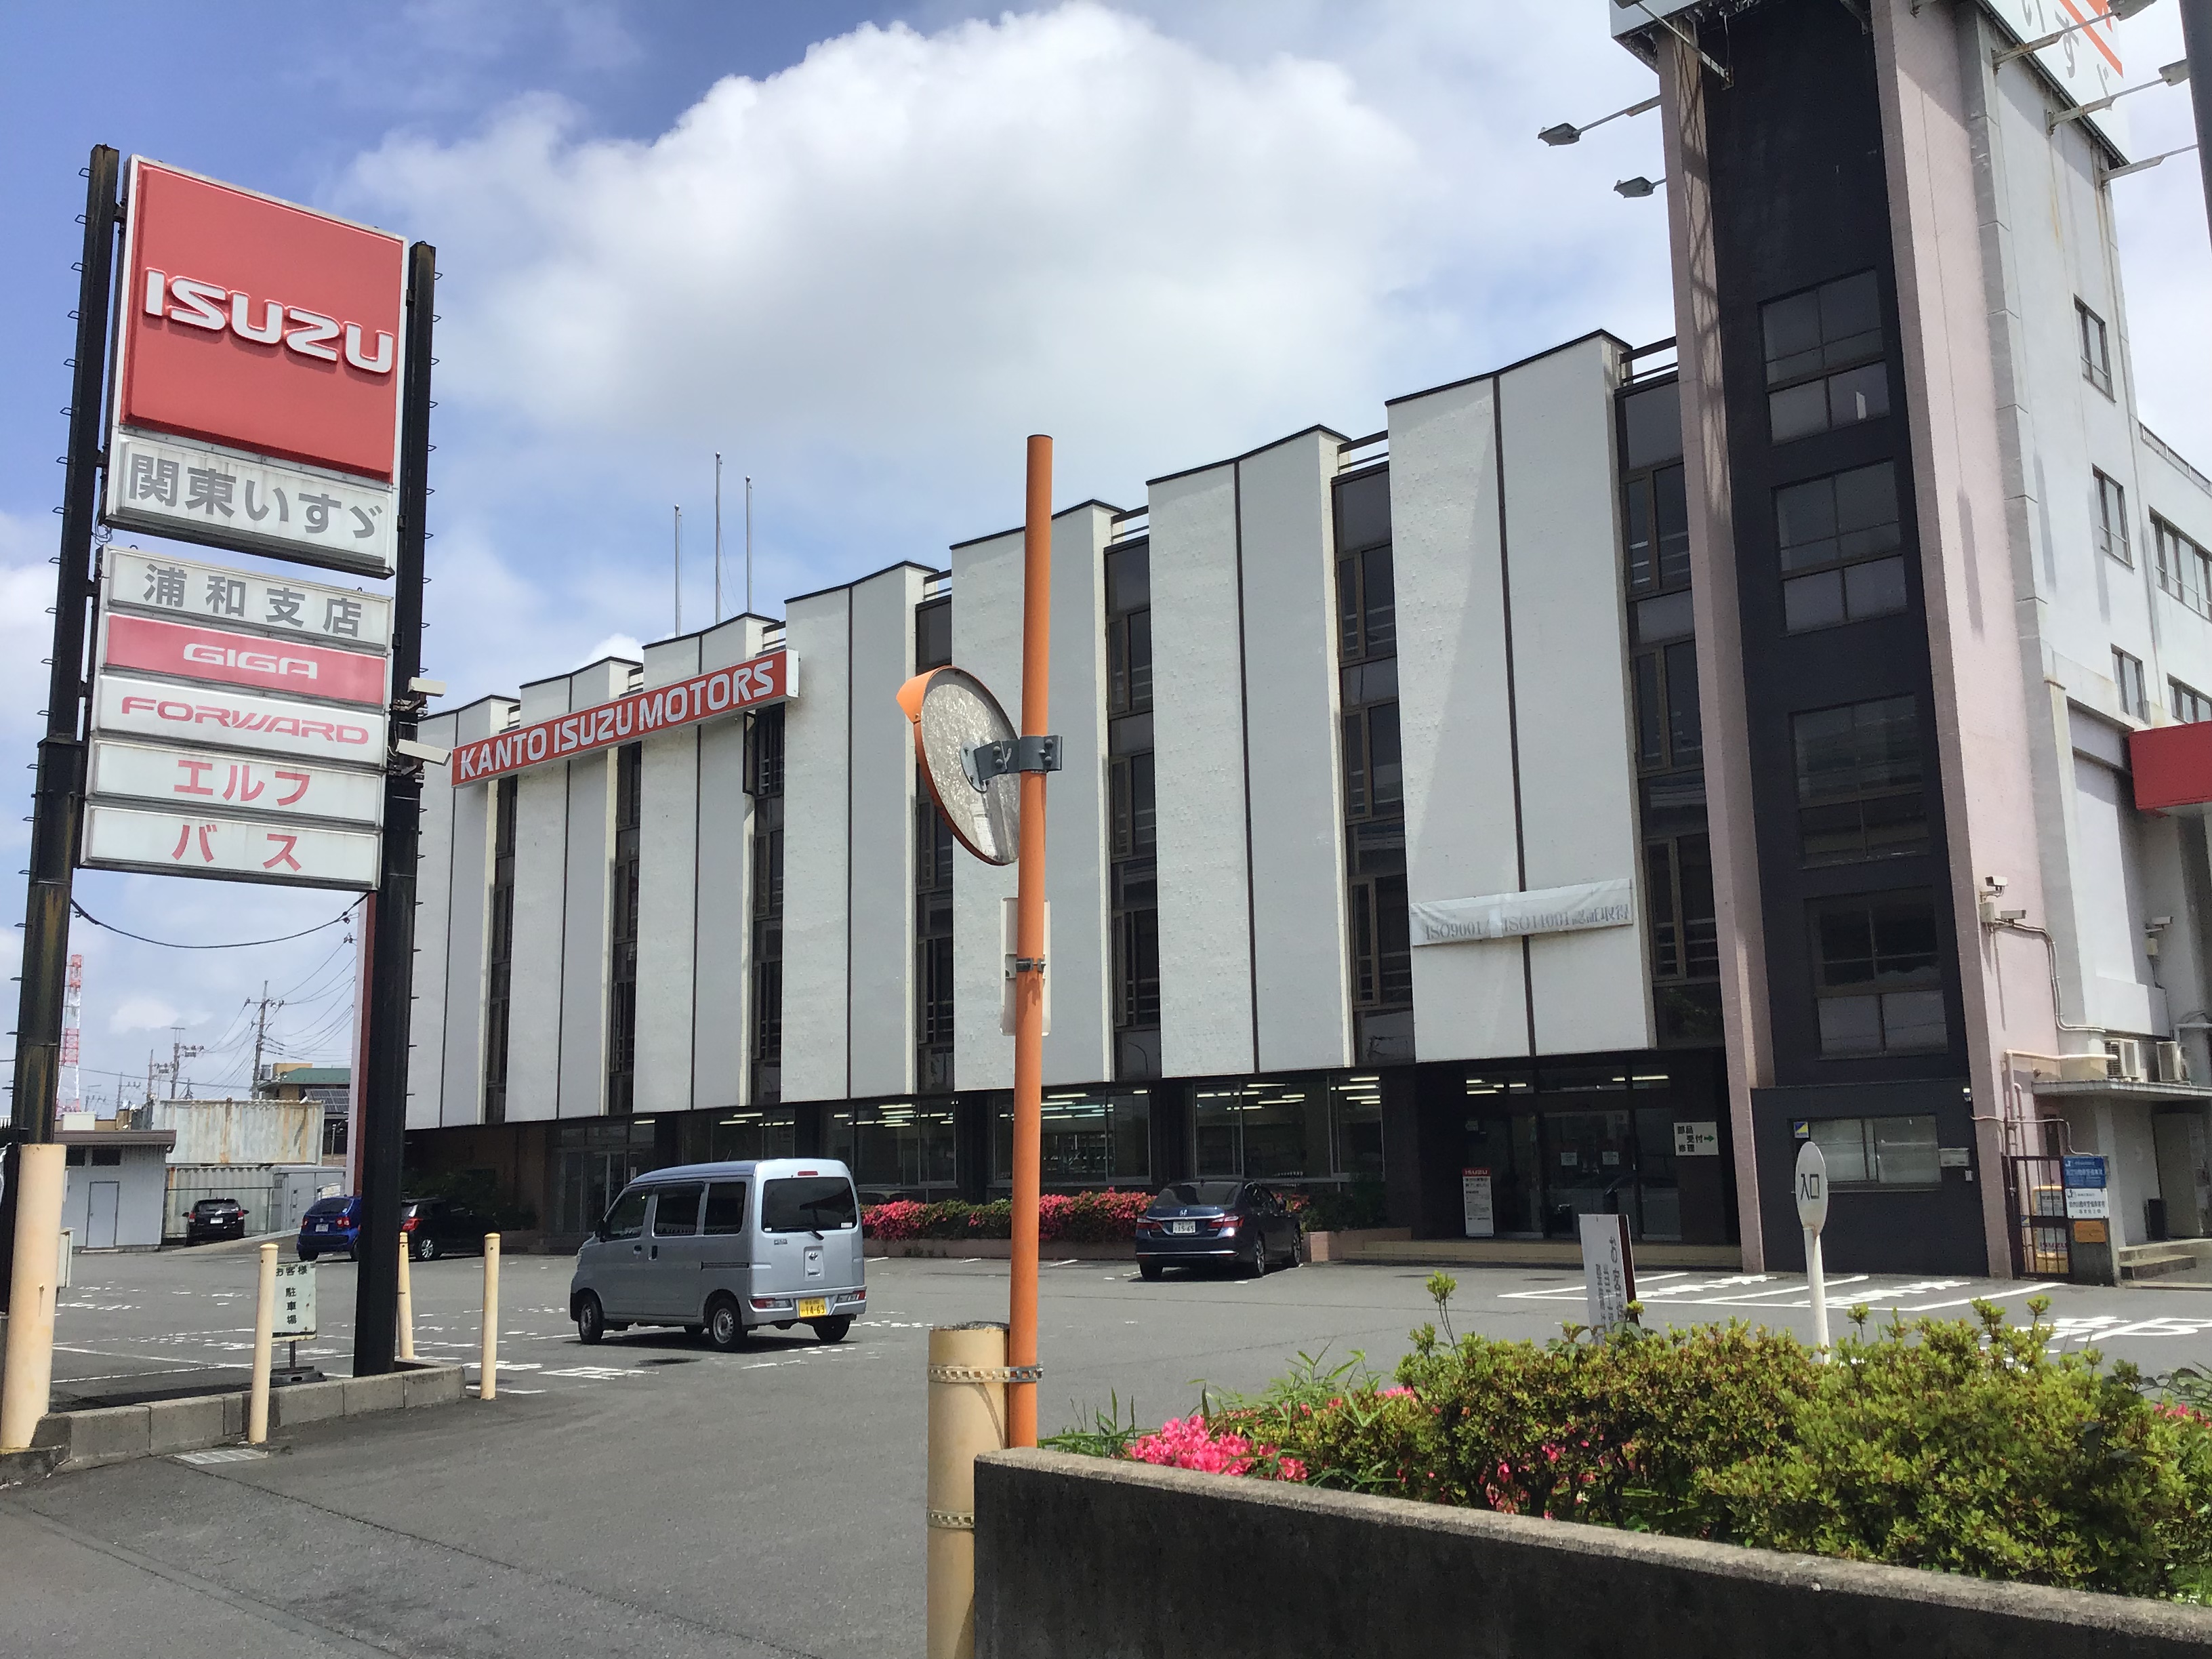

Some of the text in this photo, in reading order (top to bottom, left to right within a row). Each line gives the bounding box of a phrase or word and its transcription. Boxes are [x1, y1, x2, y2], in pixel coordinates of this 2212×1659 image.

[144, 267, 394, 373] ISUZU
[129, 453, 383, 539] 関東いすゞ
[143, 563, 362, 638] 浦和支店
[183, 642, 318, 680] GIGA
[121, 696, 369, 744] FORWARD
[459, 660, 774, 779] KANTO ISUZU MOTORS
[173, 759, 312, 806] エルフ
[171, 824, 302, 872] バス
[1800, 1173, 1820, 1201] 入口
[275, 1265, 308, 1277] お客様
[285, 1287, 297, 1325] 駐車場
